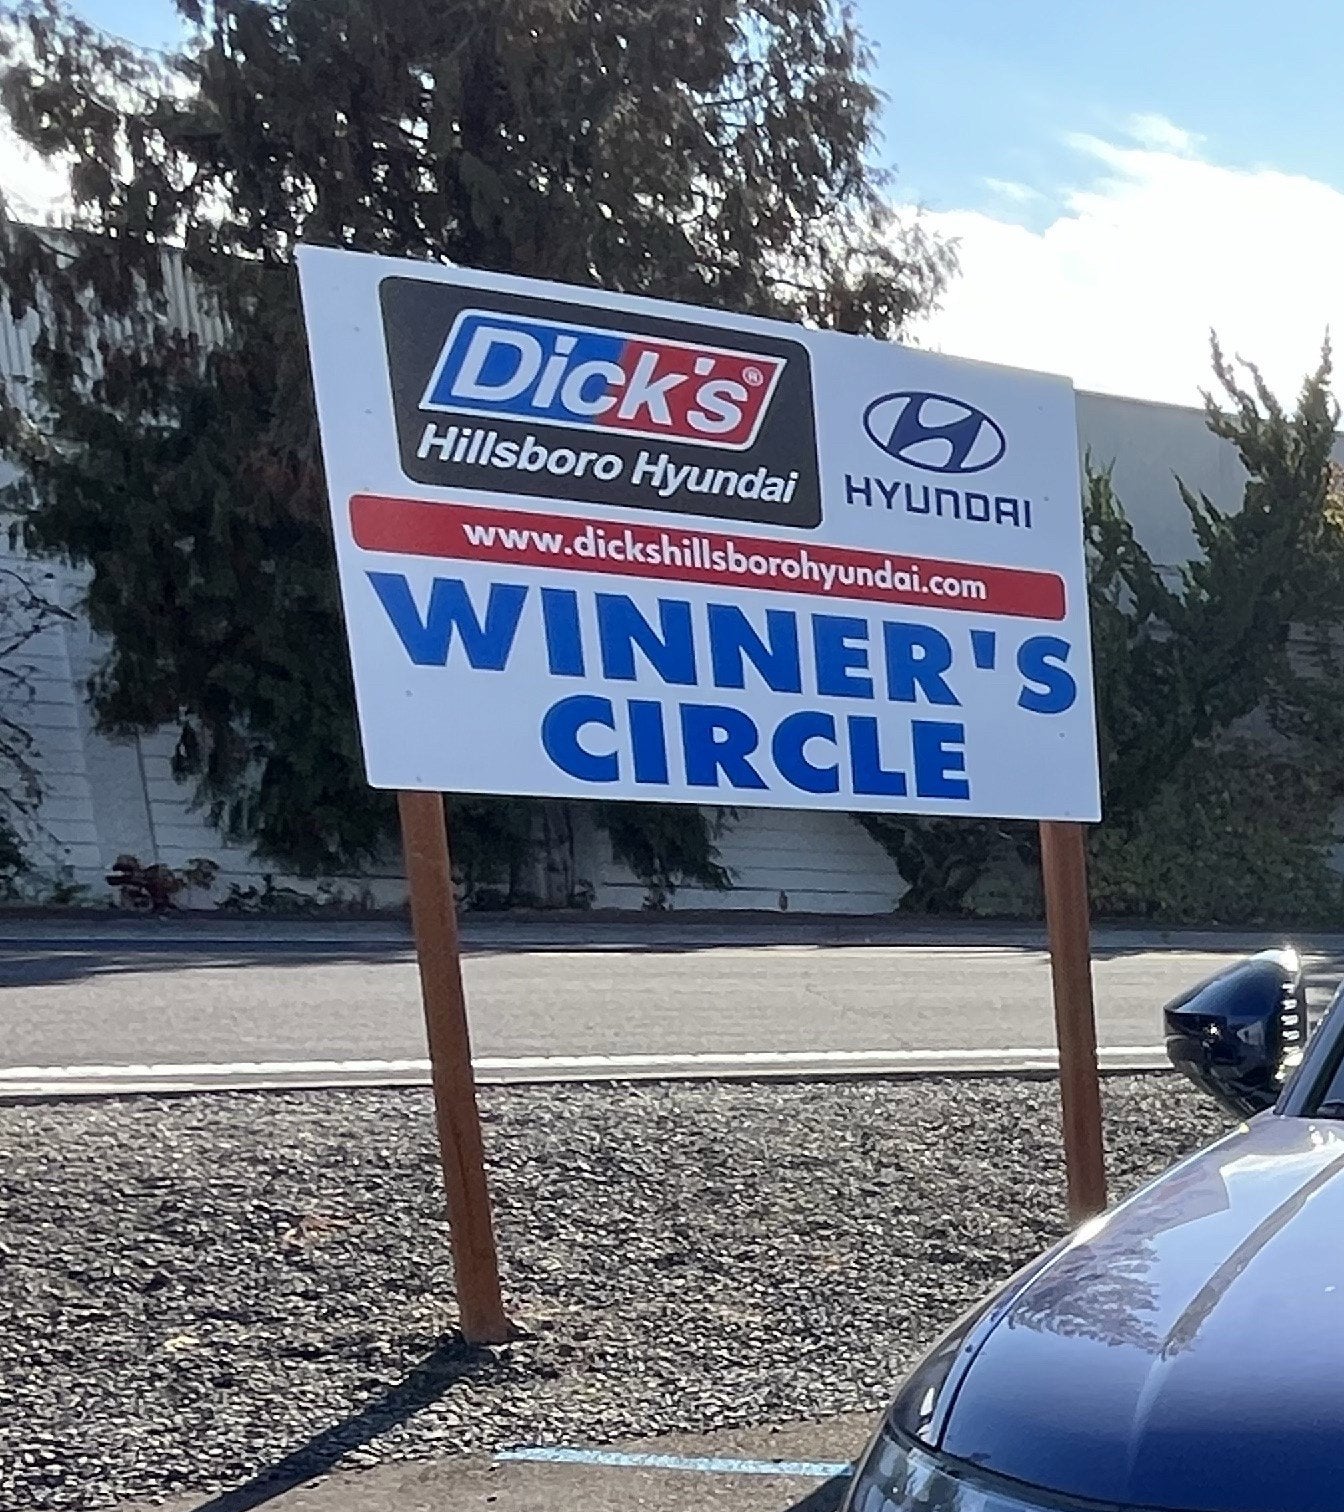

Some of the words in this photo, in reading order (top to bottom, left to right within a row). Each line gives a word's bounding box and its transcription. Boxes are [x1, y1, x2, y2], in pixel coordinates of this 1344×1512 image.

[450, 326, 749, 434] Dick's
[416, 423, 624, 482] Hillsboro
[632, 450, 799, 504] Hyundai
[845, 474, 1033, 529] HYUNDAI
[462, 520, 988, 600] www.dickshillsborohyundai.com
[366, 571, 1078, 715] WINNER'S
[540, 694, 971, 801] CIRCLE
